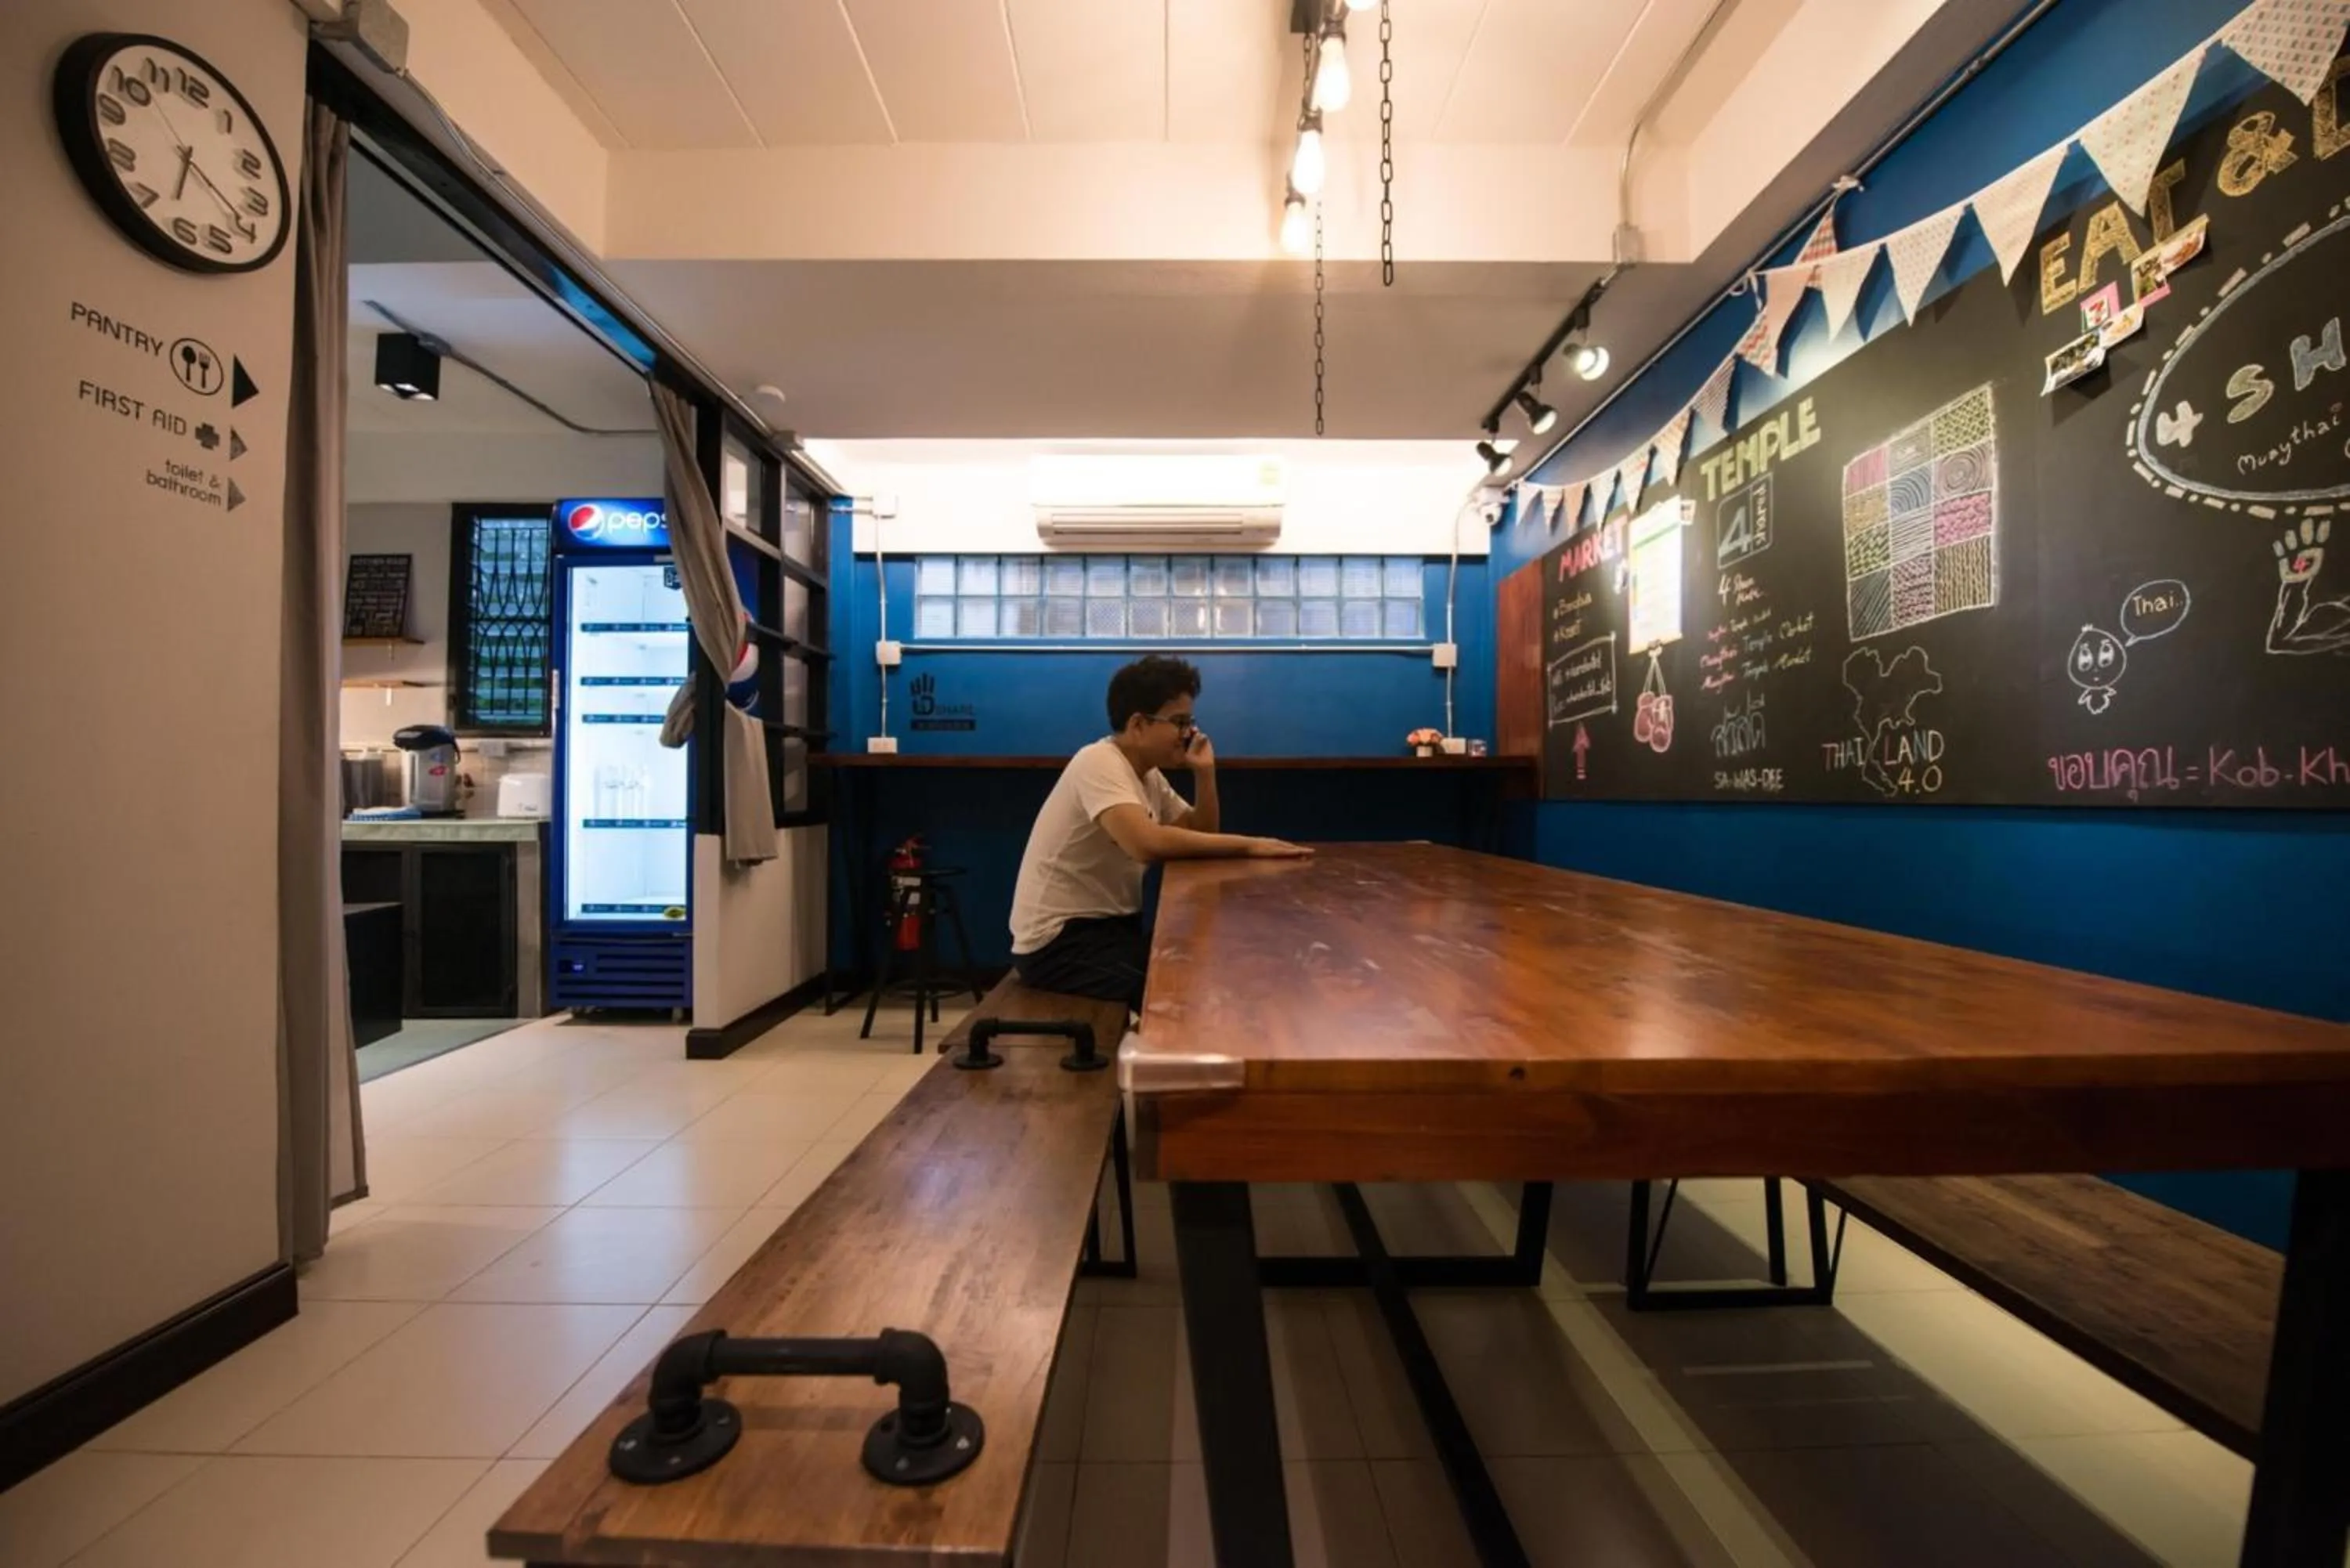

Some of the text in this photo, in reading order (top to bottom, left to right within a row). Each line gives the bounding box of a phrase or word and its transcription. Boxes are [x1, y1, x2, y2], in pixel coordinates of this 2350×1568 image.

[243, 149, 262, 179] 2
[136, 182, 160, 209] 7
[172, 218, 197, 245] 6
[2040, 158, 2186, 316] EAT
[71, 301, 164, 356] PANTRY
[79, 380, 187, 436] FIRST AID
[1700, 395, 1821, 502] TEMPLE
[146, 469, 222, 507] bathroom
[165, 458, 221, 489] toilet &
[1558, 514, 1628, 583] MARKET
[1719, 505, 1753, 557] 4
[1898, 764, 1943, 794] 4.0
